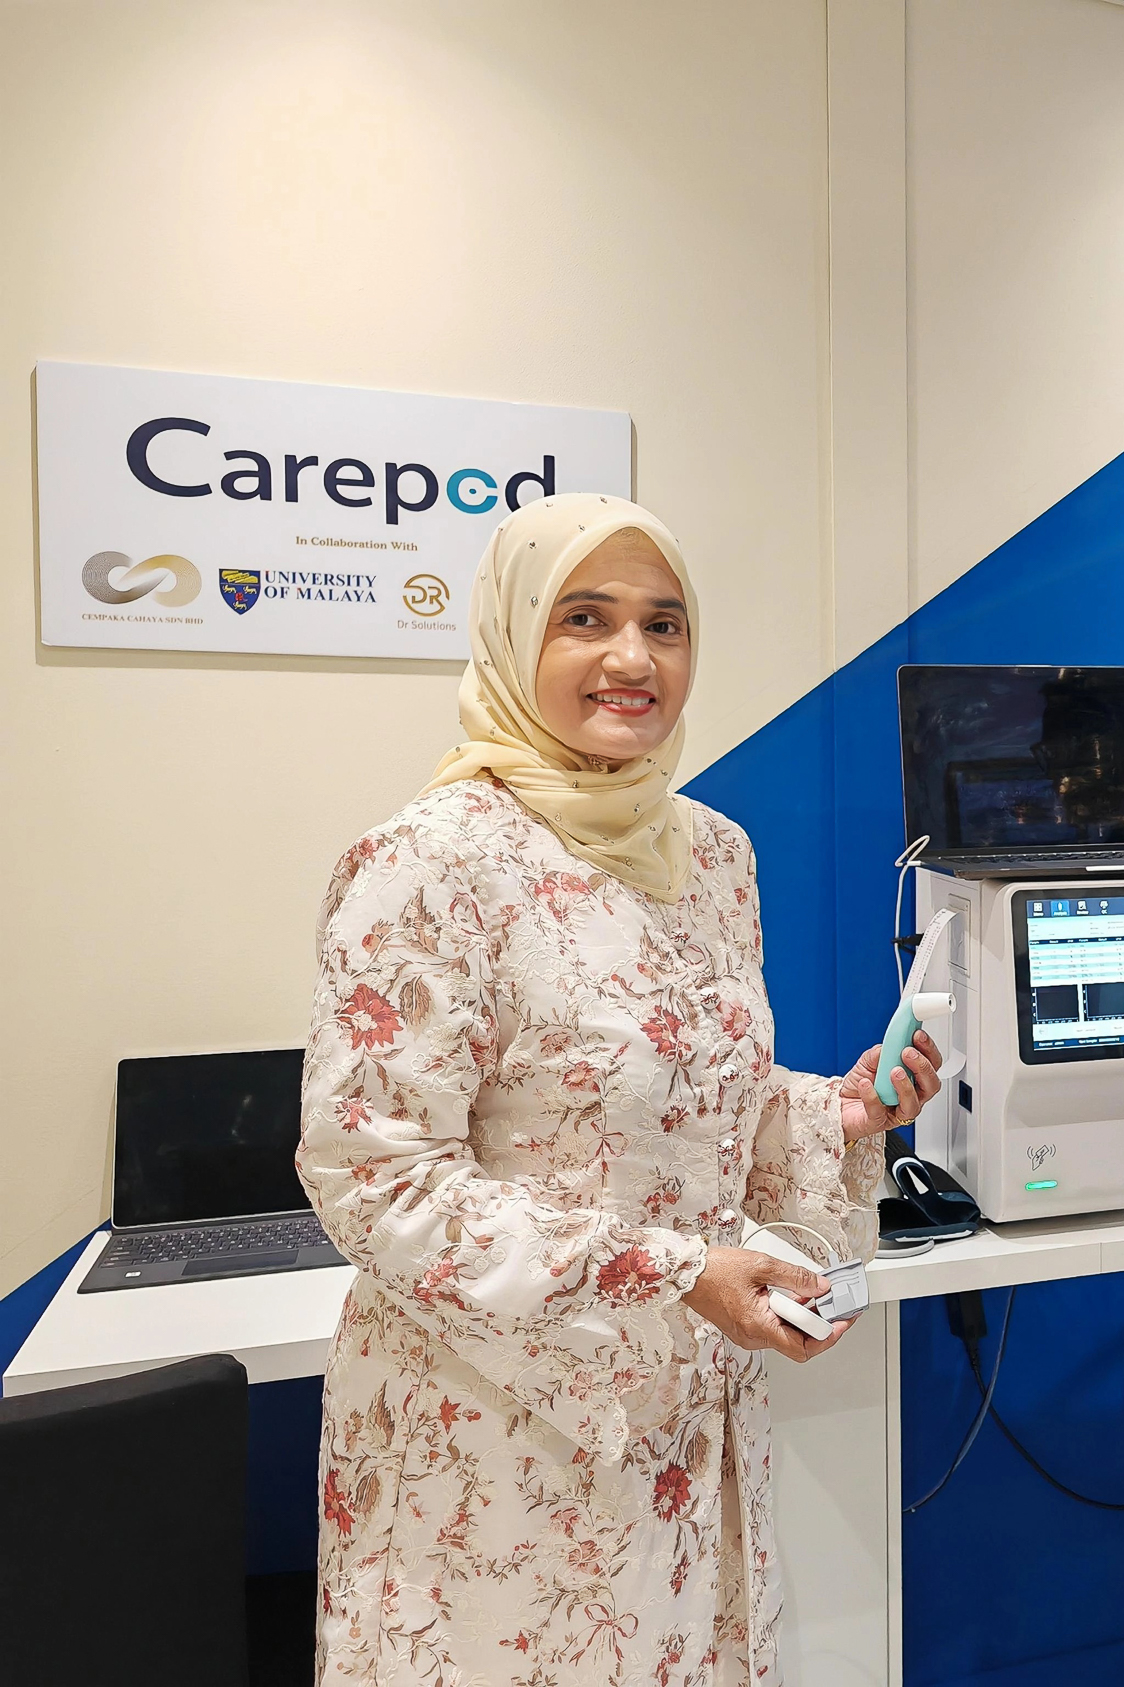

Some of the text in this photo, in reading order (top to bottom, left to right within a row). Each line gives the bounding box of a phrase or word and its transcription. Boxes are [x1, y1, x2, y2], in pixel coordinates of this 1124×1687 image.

[296, 536, 418, 552] In Collaboration With
[264, 570, 377, 588] UNIVERSITY
[264, 586, 377, 603] OF MALAYA
[82, 613, 126, 623] CEMPAKA
[164, 616, 184, 625] SDN
[185, 617, 203, 626] BHD
[397, 620, 457, 632] Dr Solutions
